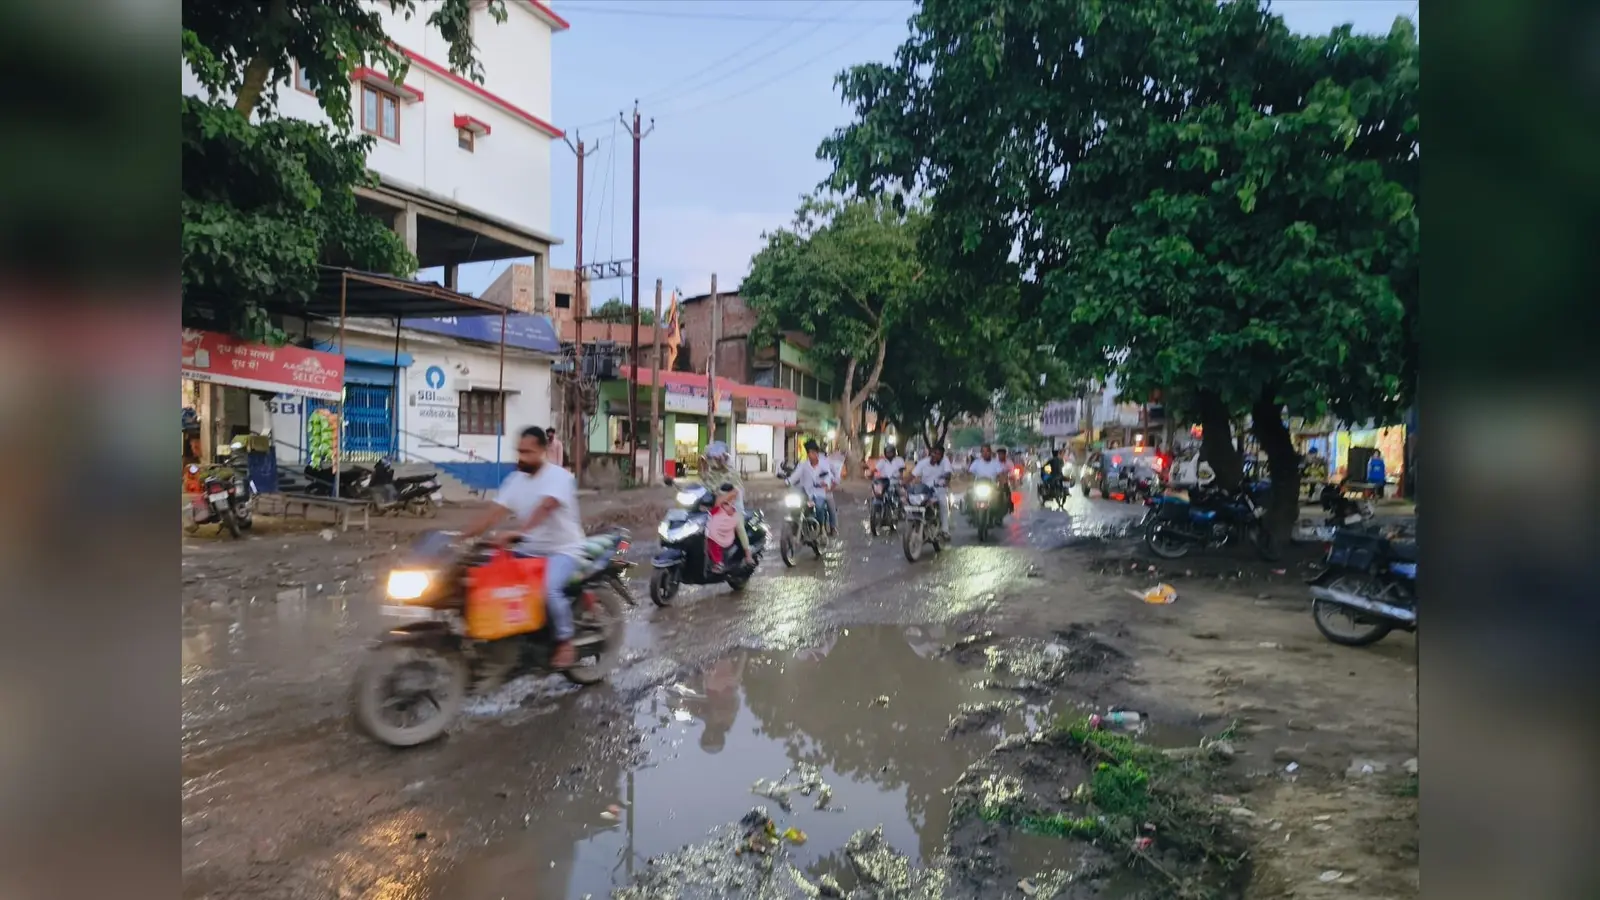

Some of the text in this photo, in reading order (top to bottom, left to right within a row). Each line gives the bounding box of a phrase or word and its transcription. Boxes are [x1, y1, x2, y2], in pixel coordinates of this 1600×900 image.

[292, 370, 328, 384] SELECT
[418, 390, 436, 401] SBI
[265, 400, 303, 415] SBI
